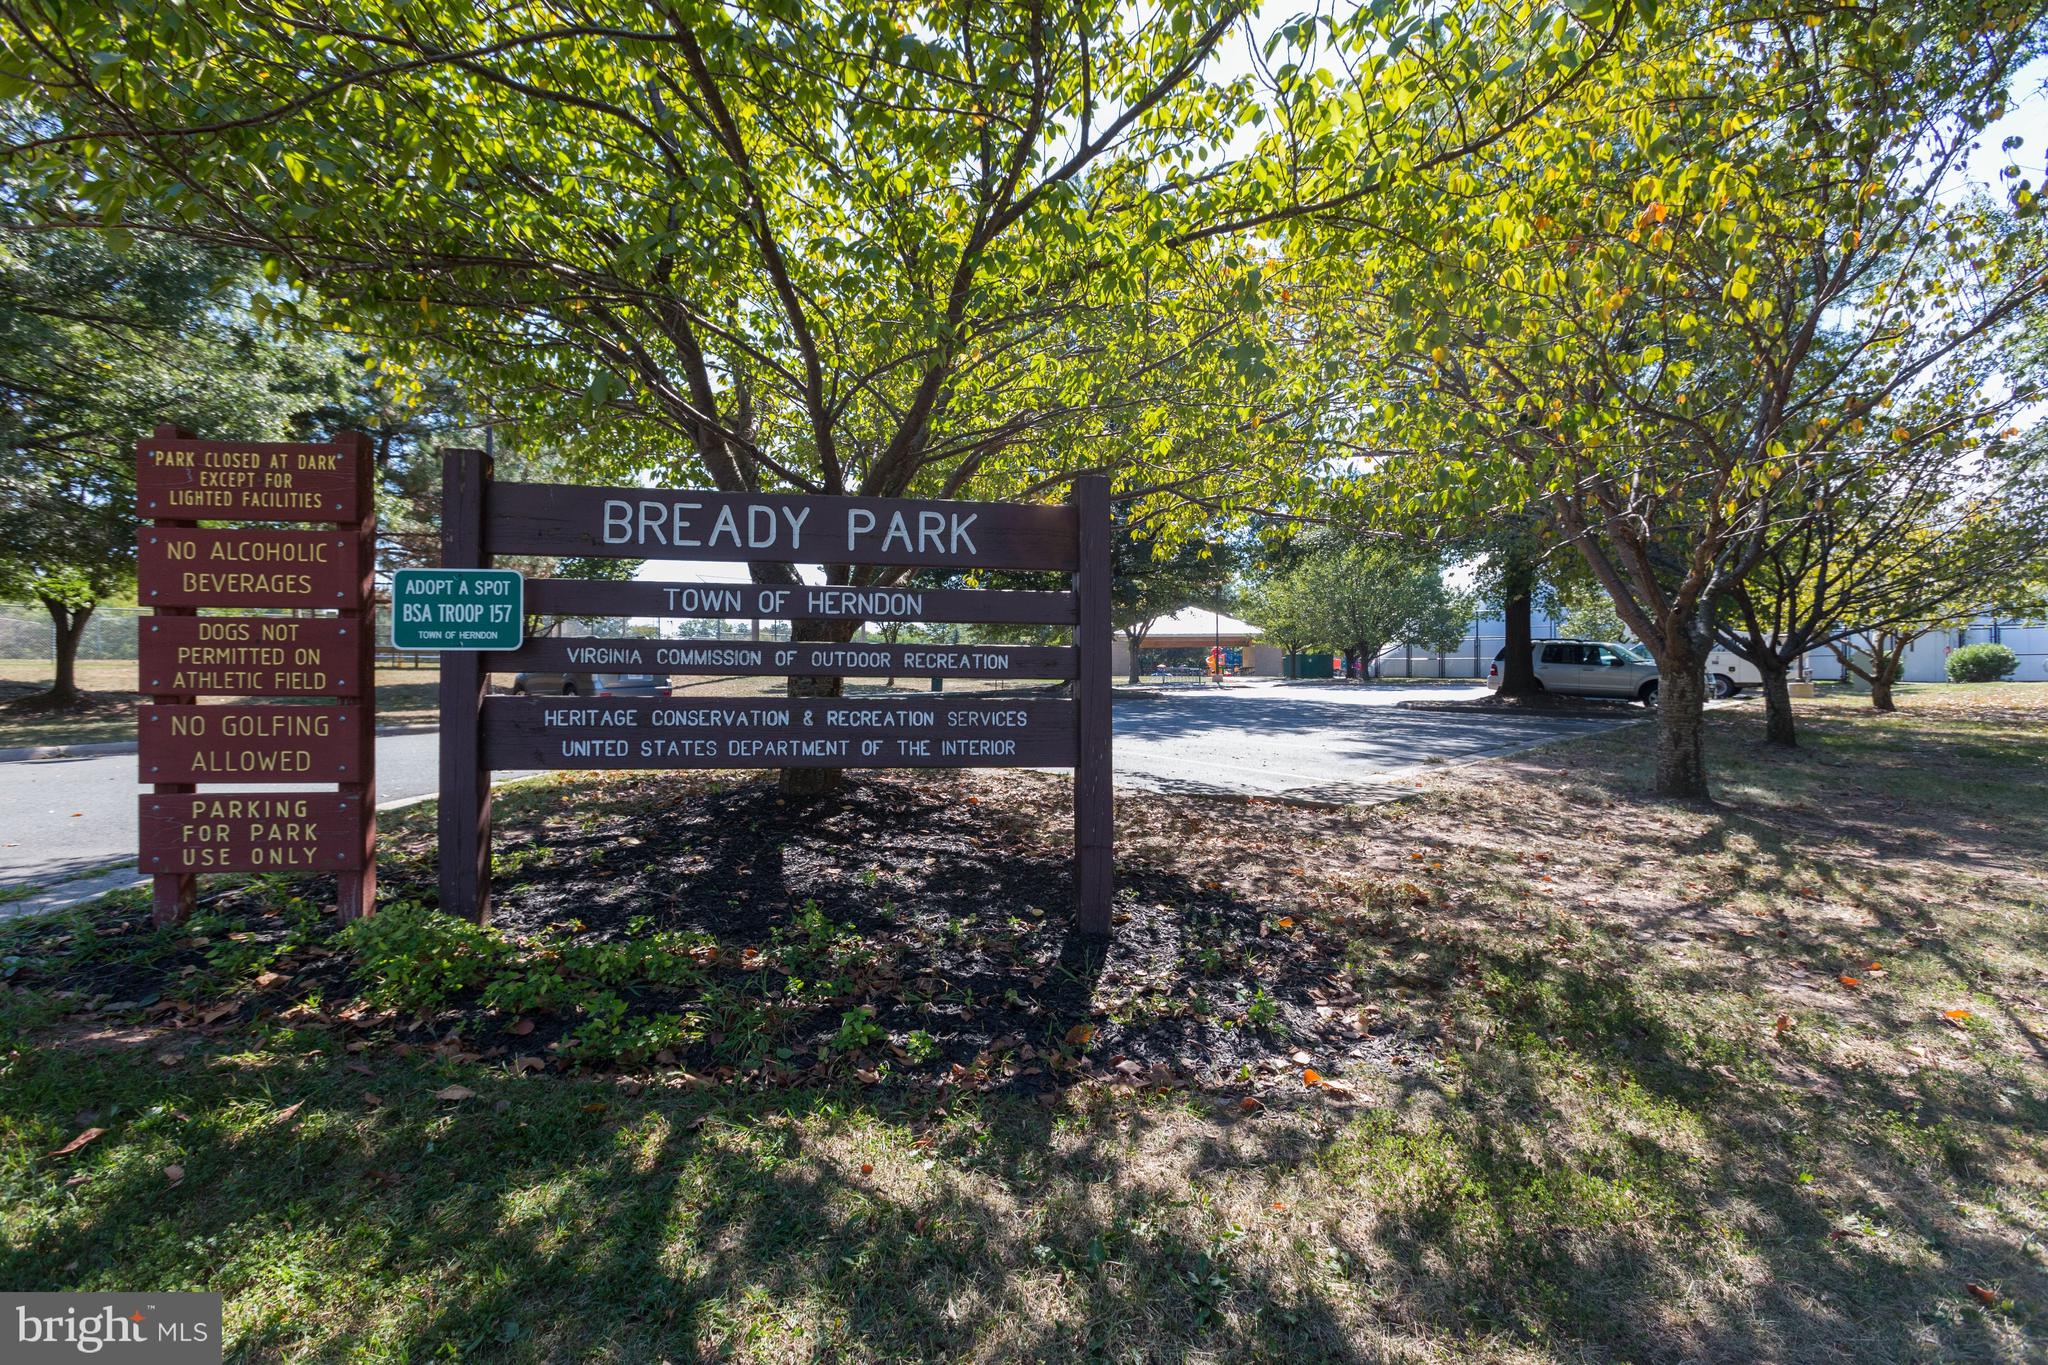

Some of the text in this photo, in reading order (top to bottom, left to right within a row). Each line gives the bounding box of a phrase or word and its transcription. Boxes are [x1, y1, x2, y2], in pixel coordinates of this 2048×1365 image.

[155, 451, 336, 471] PARK CLOSED AT DARK
[200, 472, 292, 488] EXCEPT FOR
[169, 490, 322, 508] LIGHTED FACILITIES
[603, 500, 978, 555] BREADY PARK
[167, 541, 328, 562] NO ALCOHOLIC
[183, 573, 312, 594] BEVERAGES
[405, 580, 511, 596] ADOPT A SPOT
[663, 588, 922, 616] TOWN OF HERNDON
[403, 603, 513, 623] BSA TROOP 157
[199, 623, 299, 641] DOGS NOT
[418, 630, 498, 639] TOWN OF HERNDON
[178, 647, 320, 666] PERMITTED ON
[566, 647, 1009, 670] VIRGINIA COMMISSION OF OUTDOOR RECREATION
[172, 672, 326, 690] ATHLETIC FIELD
[171, 716, 330, 737] NO GOLFING
[544, 709, 1028, 727] HERITAGE CONSERVATION & RECREATION SERVICES
[562, 740, 1016, 757] UNITED STATES DEPARTMENT OF THE INTERIOR
[191, 751, 311, 772] ALLOWED
[192, 800, 308, 819] PARKING
[183, 823, 317, 842] FOR PARK
[183, 847, 318, 866] USE ONLY
